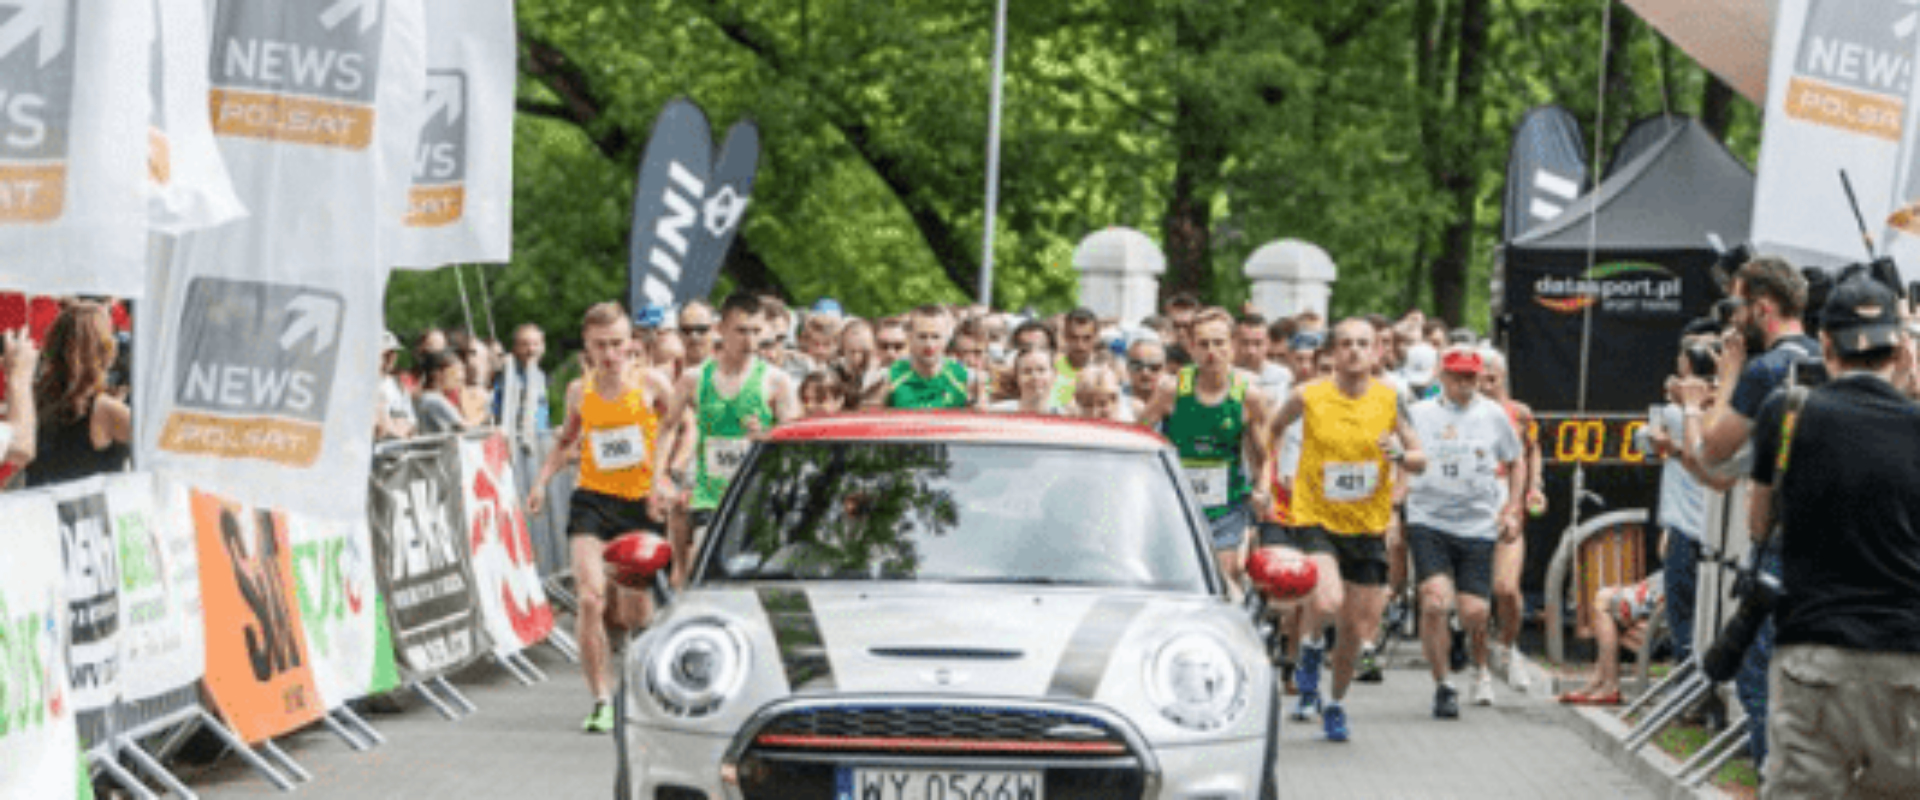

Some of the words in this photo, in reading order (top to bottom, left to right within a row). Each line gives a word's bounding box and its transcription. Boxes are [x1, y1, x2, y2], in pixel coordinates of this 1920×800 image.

[222, 38, 364, 92] NEWS
[218, 102, 359, 137] POLSAT
[183, 360, 317, 411] NEWS
